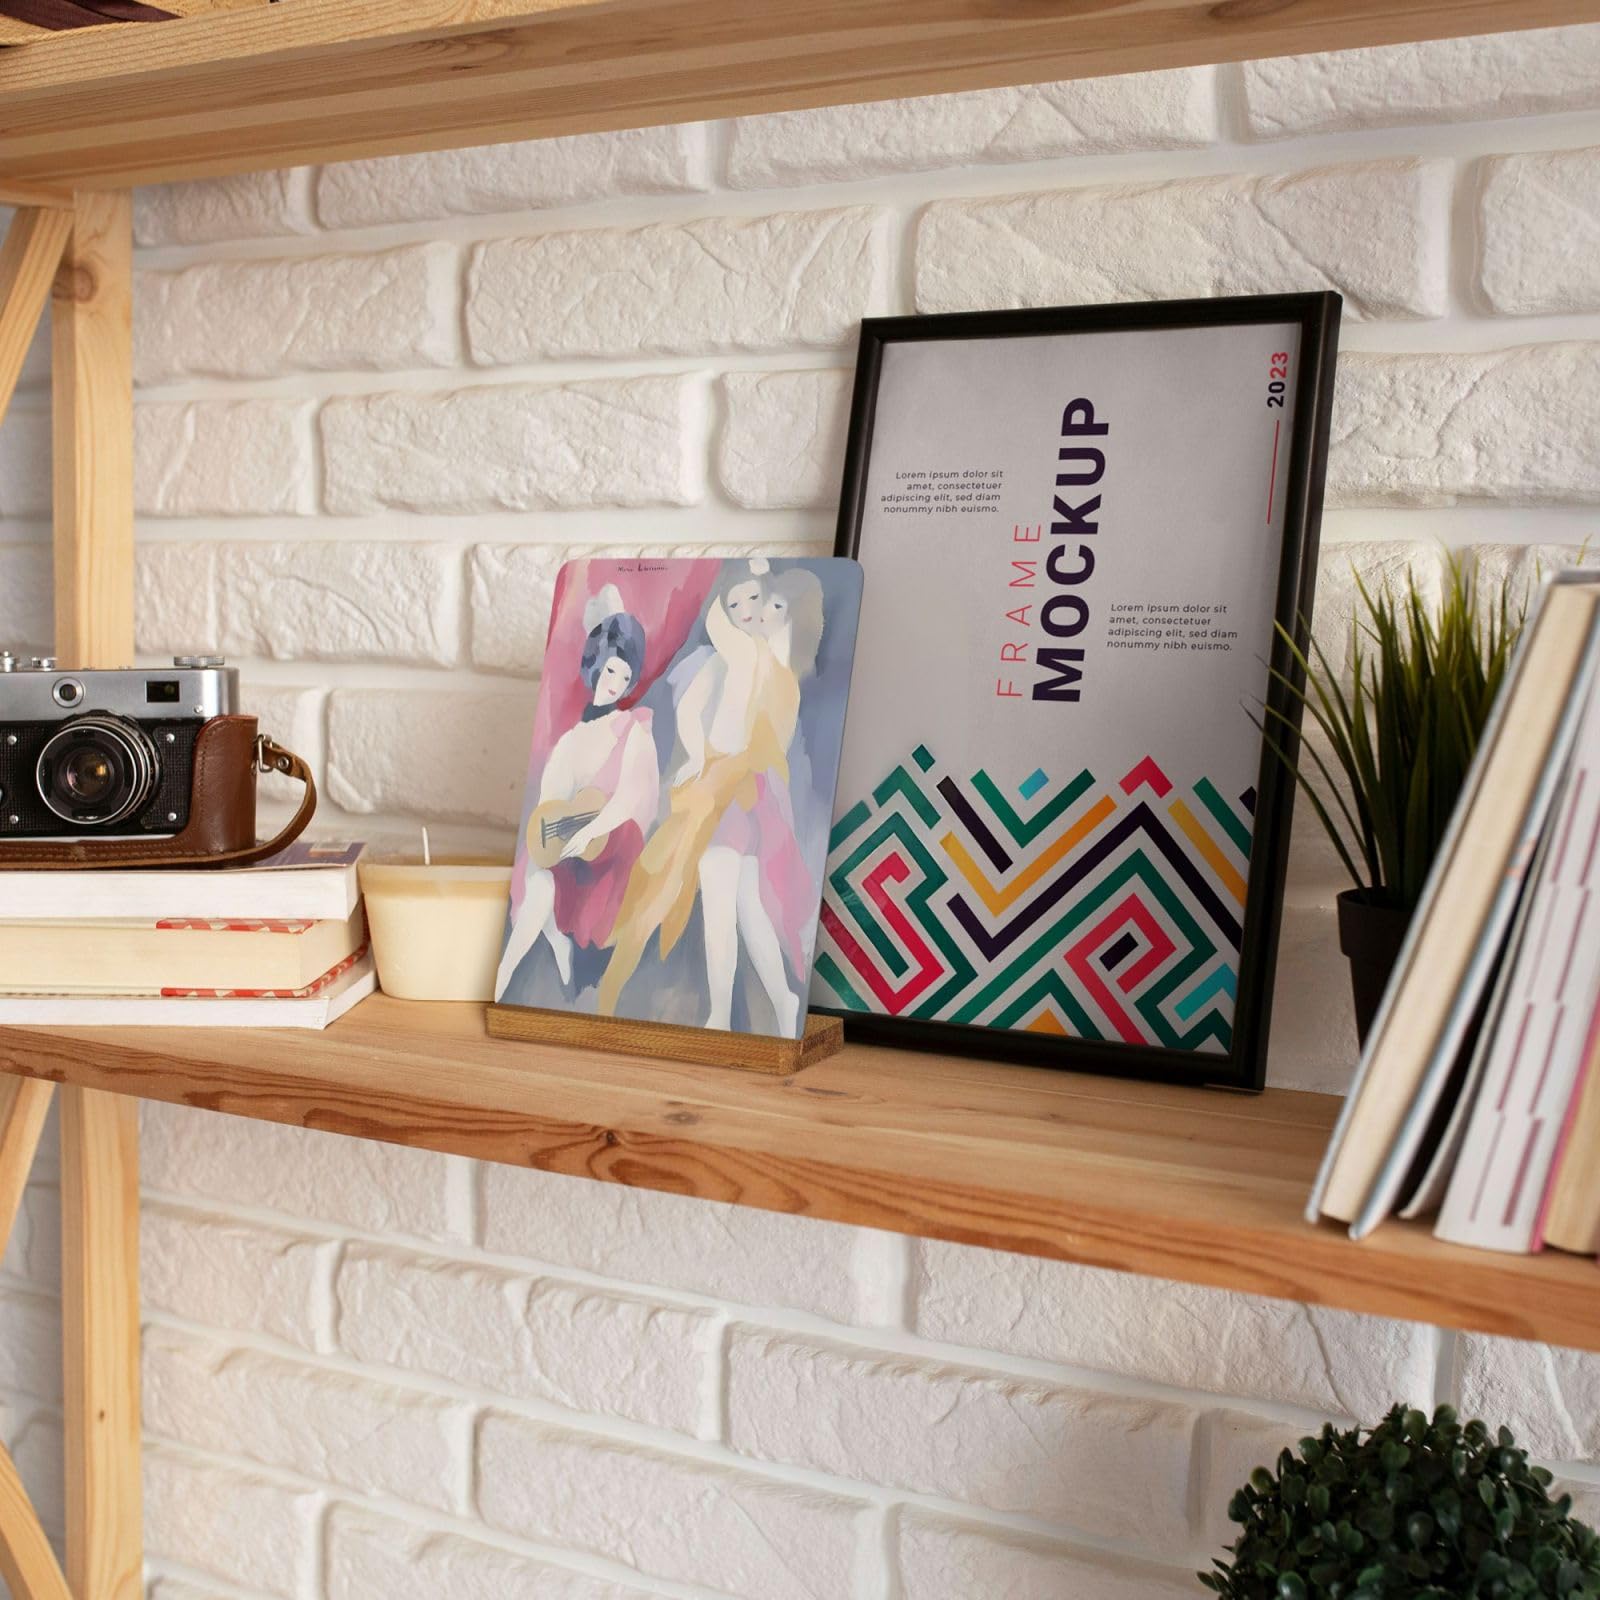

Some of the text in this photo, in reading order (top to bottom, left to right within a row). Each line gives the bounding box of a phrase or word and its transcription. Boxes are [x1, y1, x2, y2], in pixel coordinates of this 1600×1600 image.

[1267, 352, 1288, 408] 2023
[895, 470, 1004, 481] Lorem ipsum dolor sit
[906, 482, 1002, 491] amet, consectetuer
[881, 493, 1001, 503] adipiscing elit, sed diam
[883, 504, 999, 515] nonummy nibh euismo.
[1032, 397, 1109, 702] MOCKUP
[996, 524, 1041, 696] FRAME
[1111, 603, 1228, 613] Lorem ipsum dolor sit
[1109, 616, 1211, 626] amet, consectetuer
[1107, 628, 1238, 639] adipiscing elit, sed diam
[1106, 640, 1232, 651] nonummy nibh euismo.
